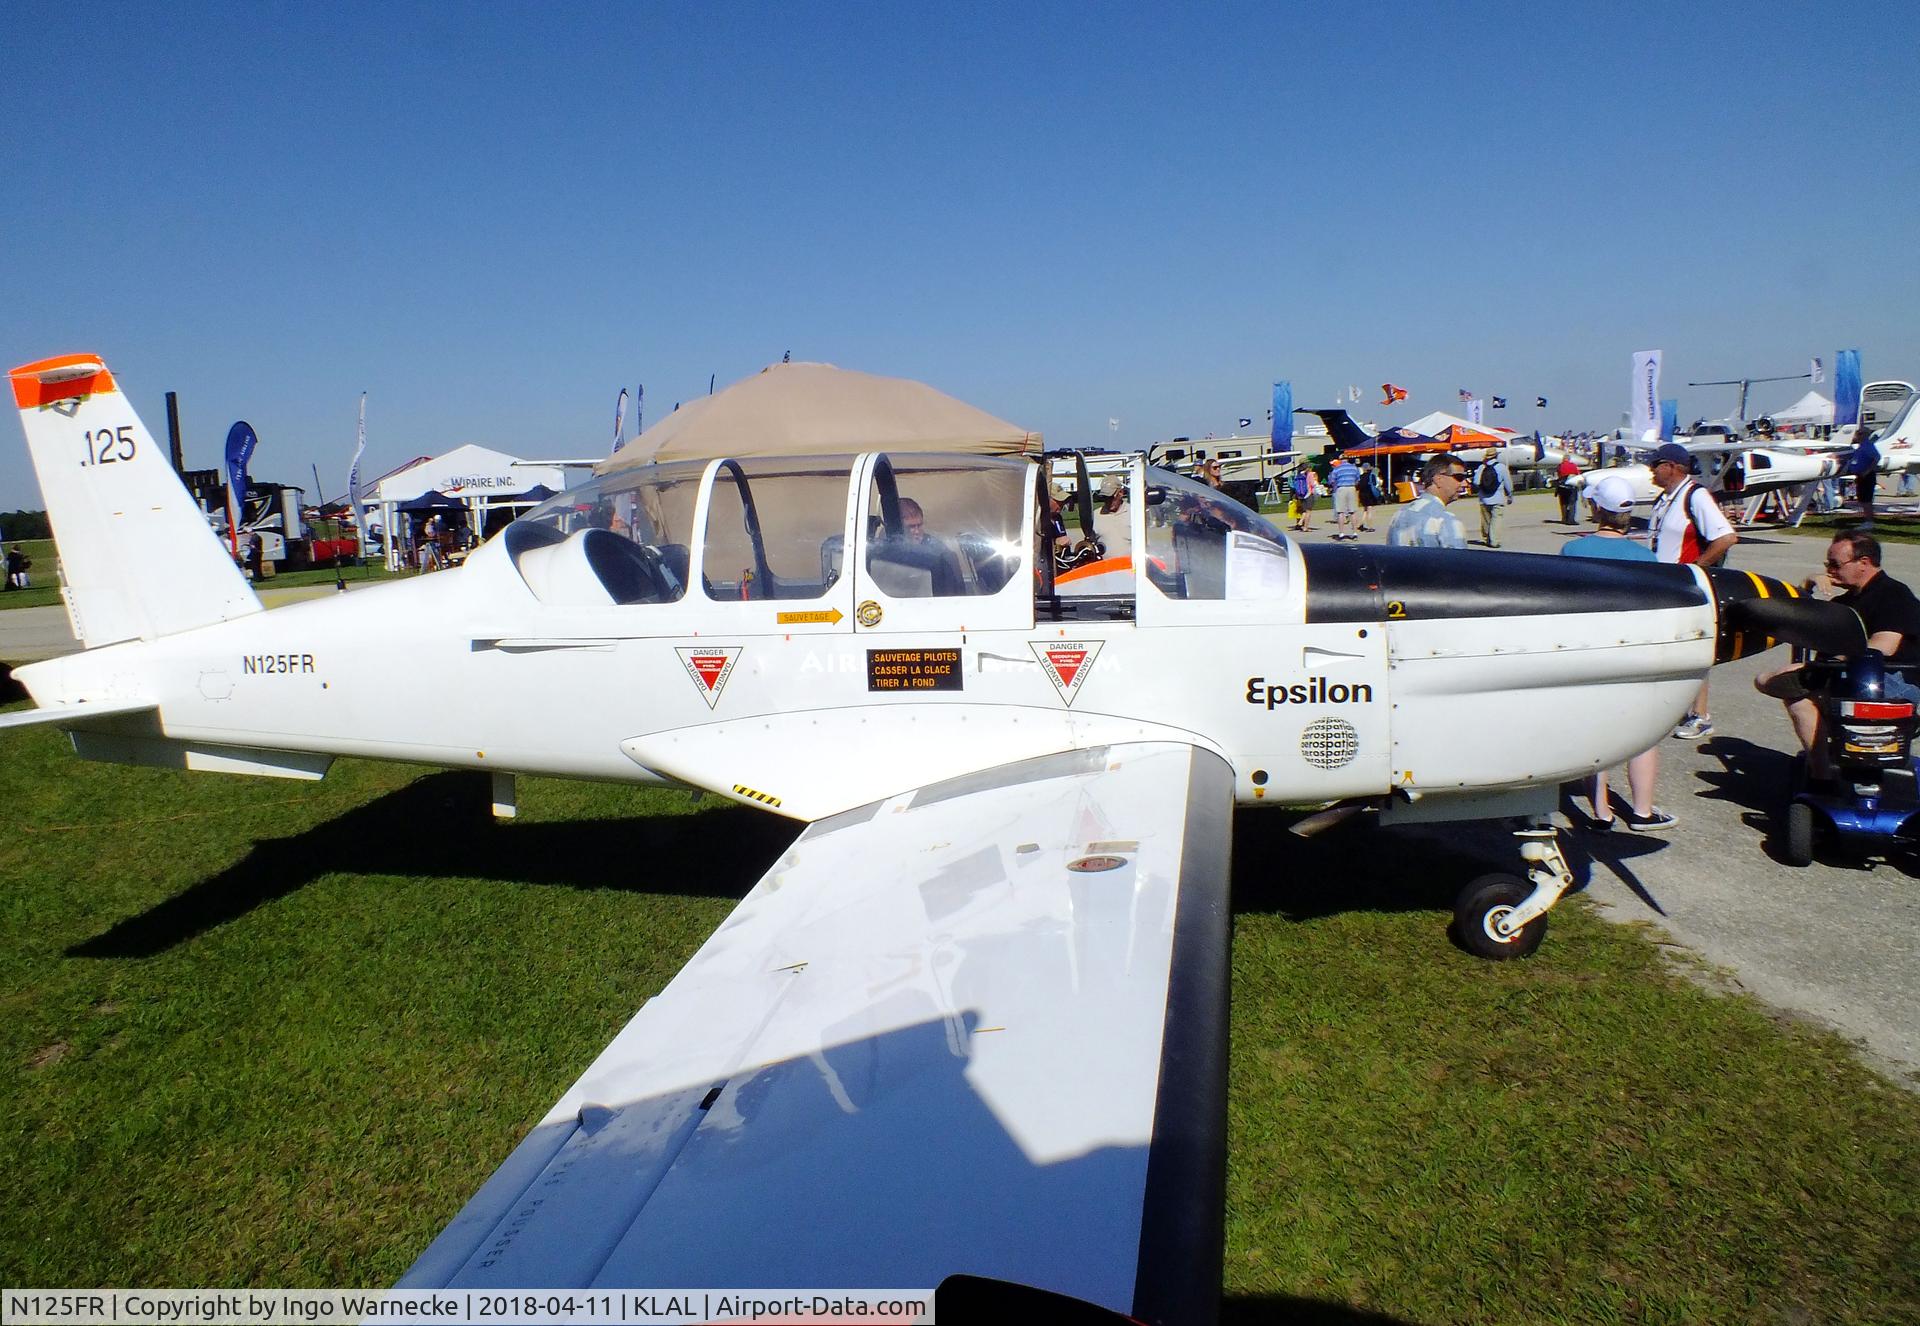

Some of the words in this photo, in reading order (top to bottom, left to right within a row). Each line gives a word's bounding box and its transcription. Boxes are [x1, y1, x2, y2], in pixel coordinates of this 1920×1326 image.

[496, 476, 515, 487] INC.
[783, 613, 830, 622] SAUVETAGE
[1389, 601, 1407, 617] 2
[243, 654, 315, 674] N125FR
[924, 652, 958, 662] PILOTES
[687, 662, 707, 692] DANGER
[714, 662, 732, 692] DANGER
[910, 665, 921, 674] LA
[924, 665, 951, 674] GLACE
[1042, 656, 1064, 688] DANGER
[1072, 656, 1092, 688] DANGER
[903, 678, 909, 687] A
[912, 678, 935, 687] FOND
[1246, 676, 1372, 710] Epsilon
